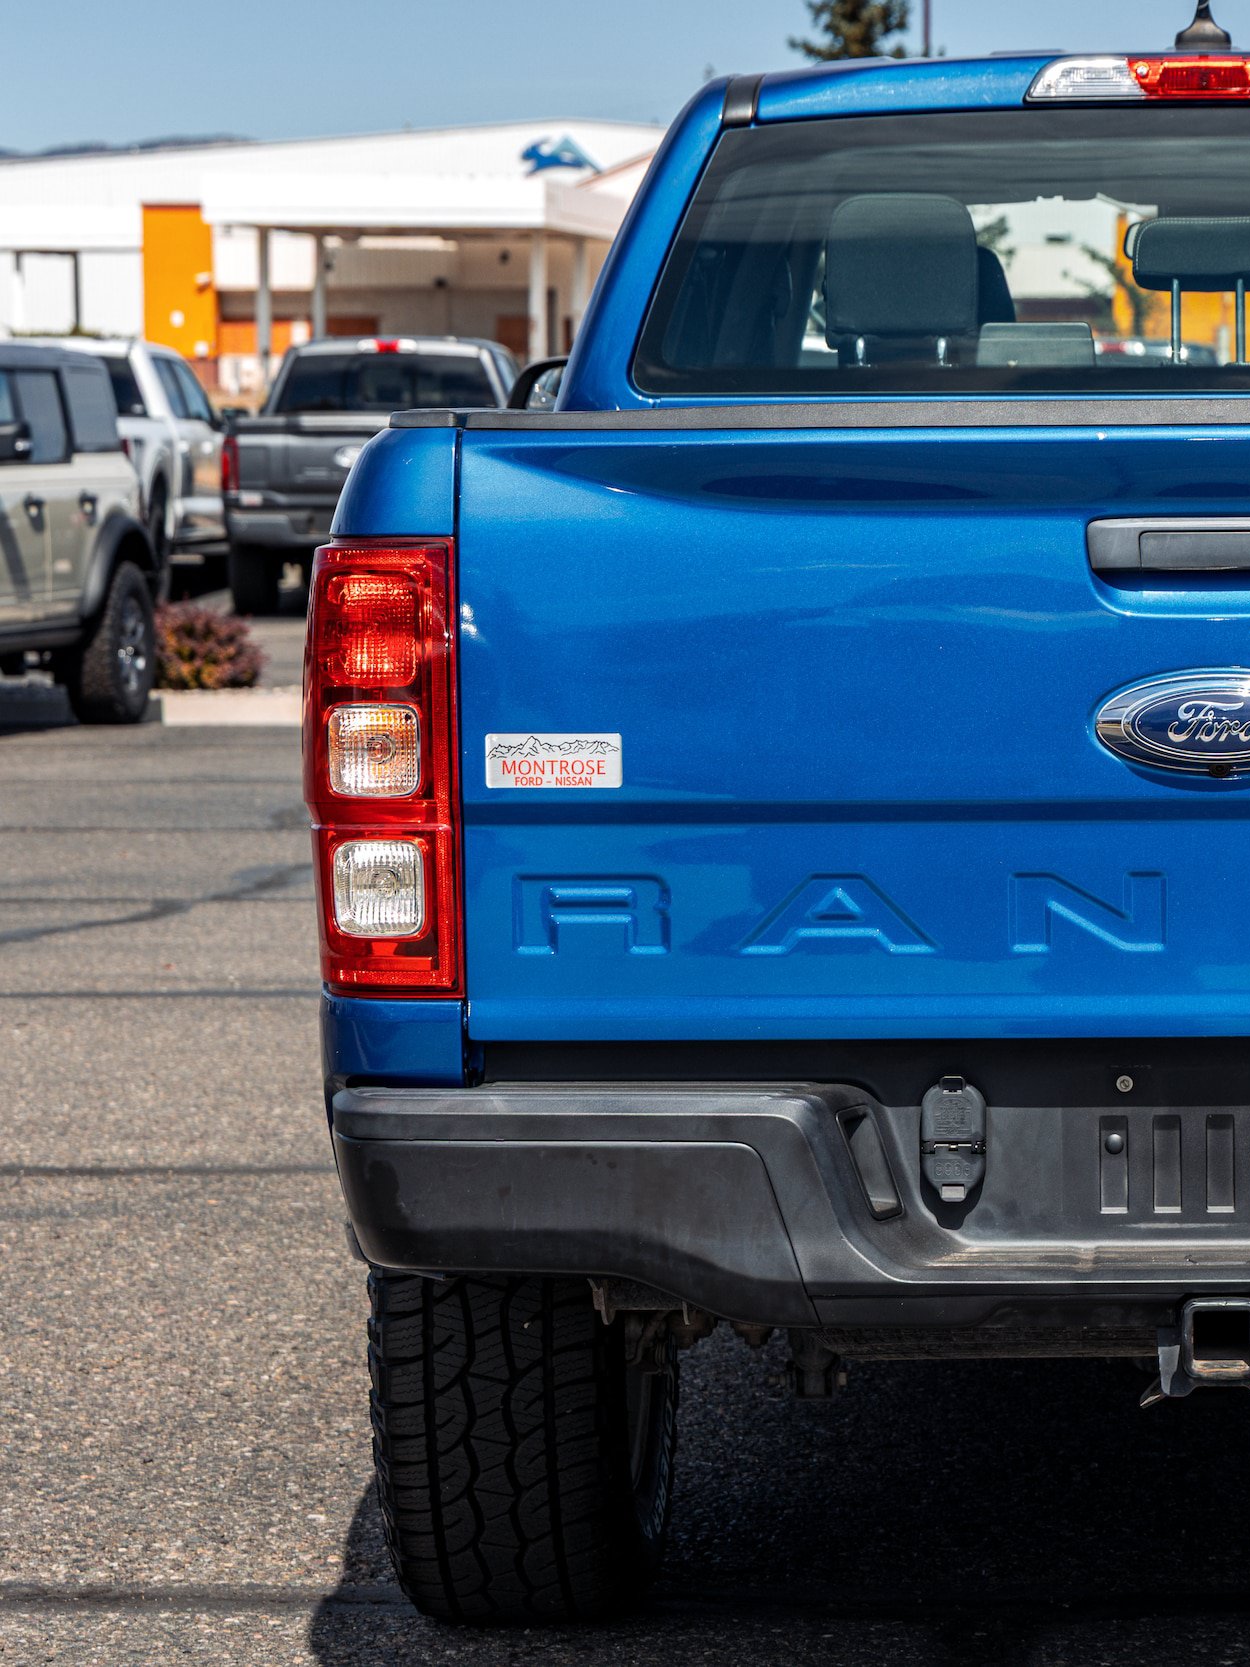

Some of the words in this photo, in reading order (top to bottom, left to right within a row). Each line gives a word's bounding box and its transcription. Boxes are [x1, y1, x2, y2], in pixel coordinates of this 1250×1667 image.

[501, 759, 606, 775] MONTROSE
[514, 776, 543, 786] FORD
[555, 776, 592, 786] NISSAN
